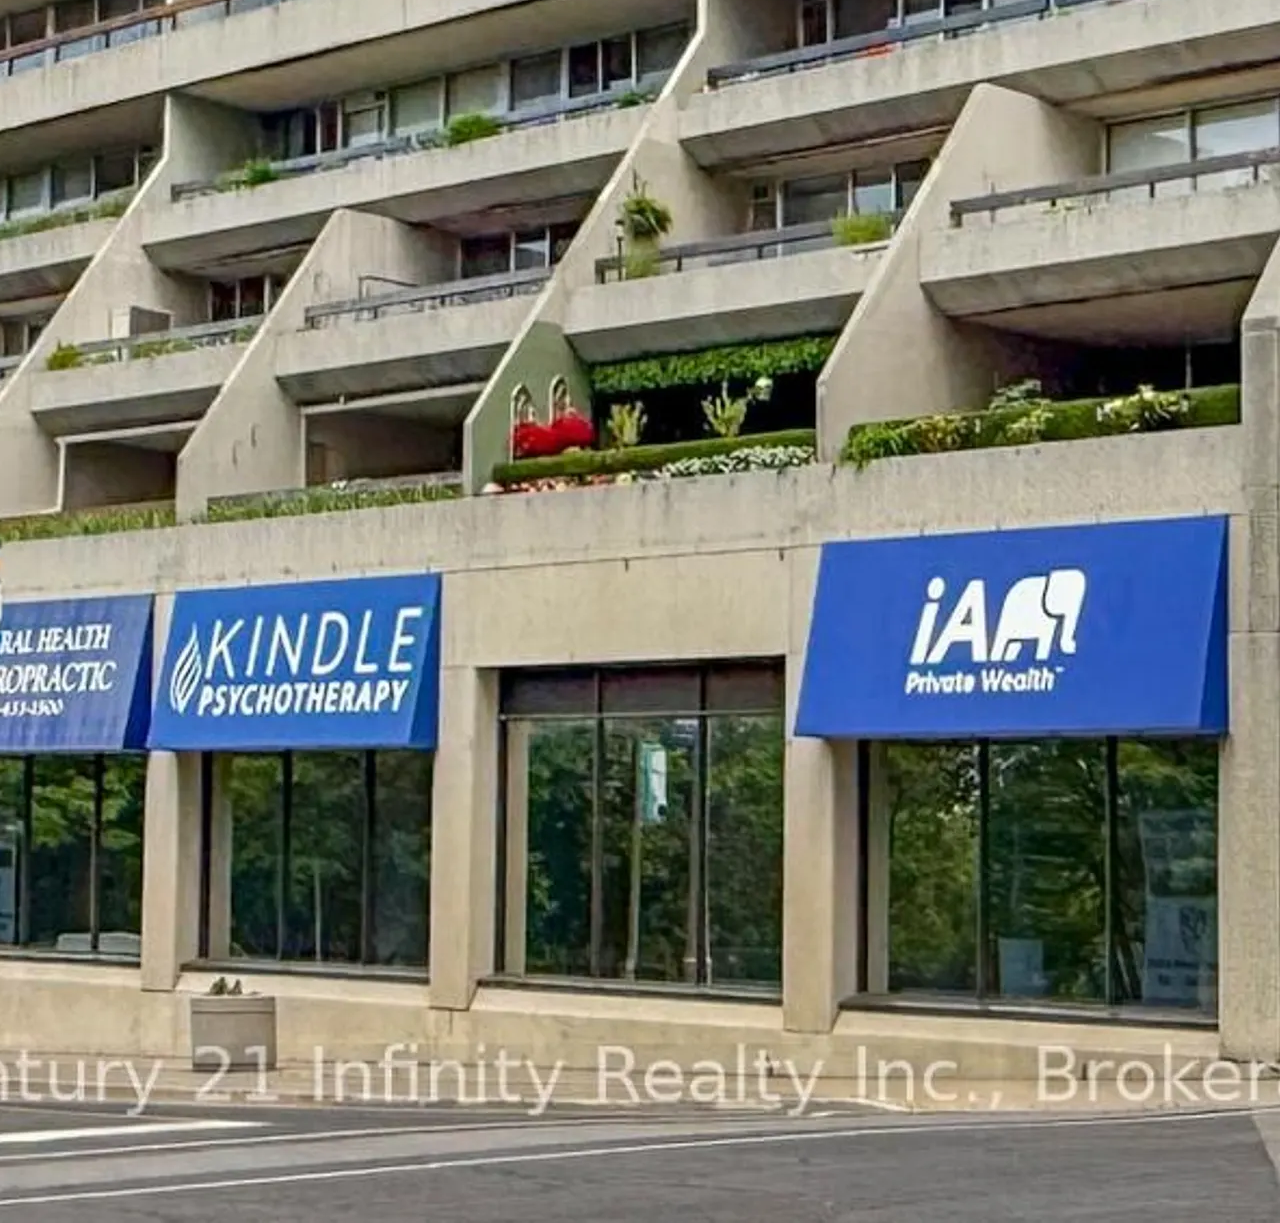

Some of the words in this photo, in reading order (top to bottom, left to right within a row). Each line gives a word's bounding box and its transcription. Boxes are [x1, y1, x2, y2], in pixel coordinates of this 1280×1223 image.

[37, 624, 113, 653] HEALTH
[204, 606, 423, 680] KINDLE
[197, 679, 410, 717] PSYCHOTHERAPY
[905, 670, 974, 694] Private
